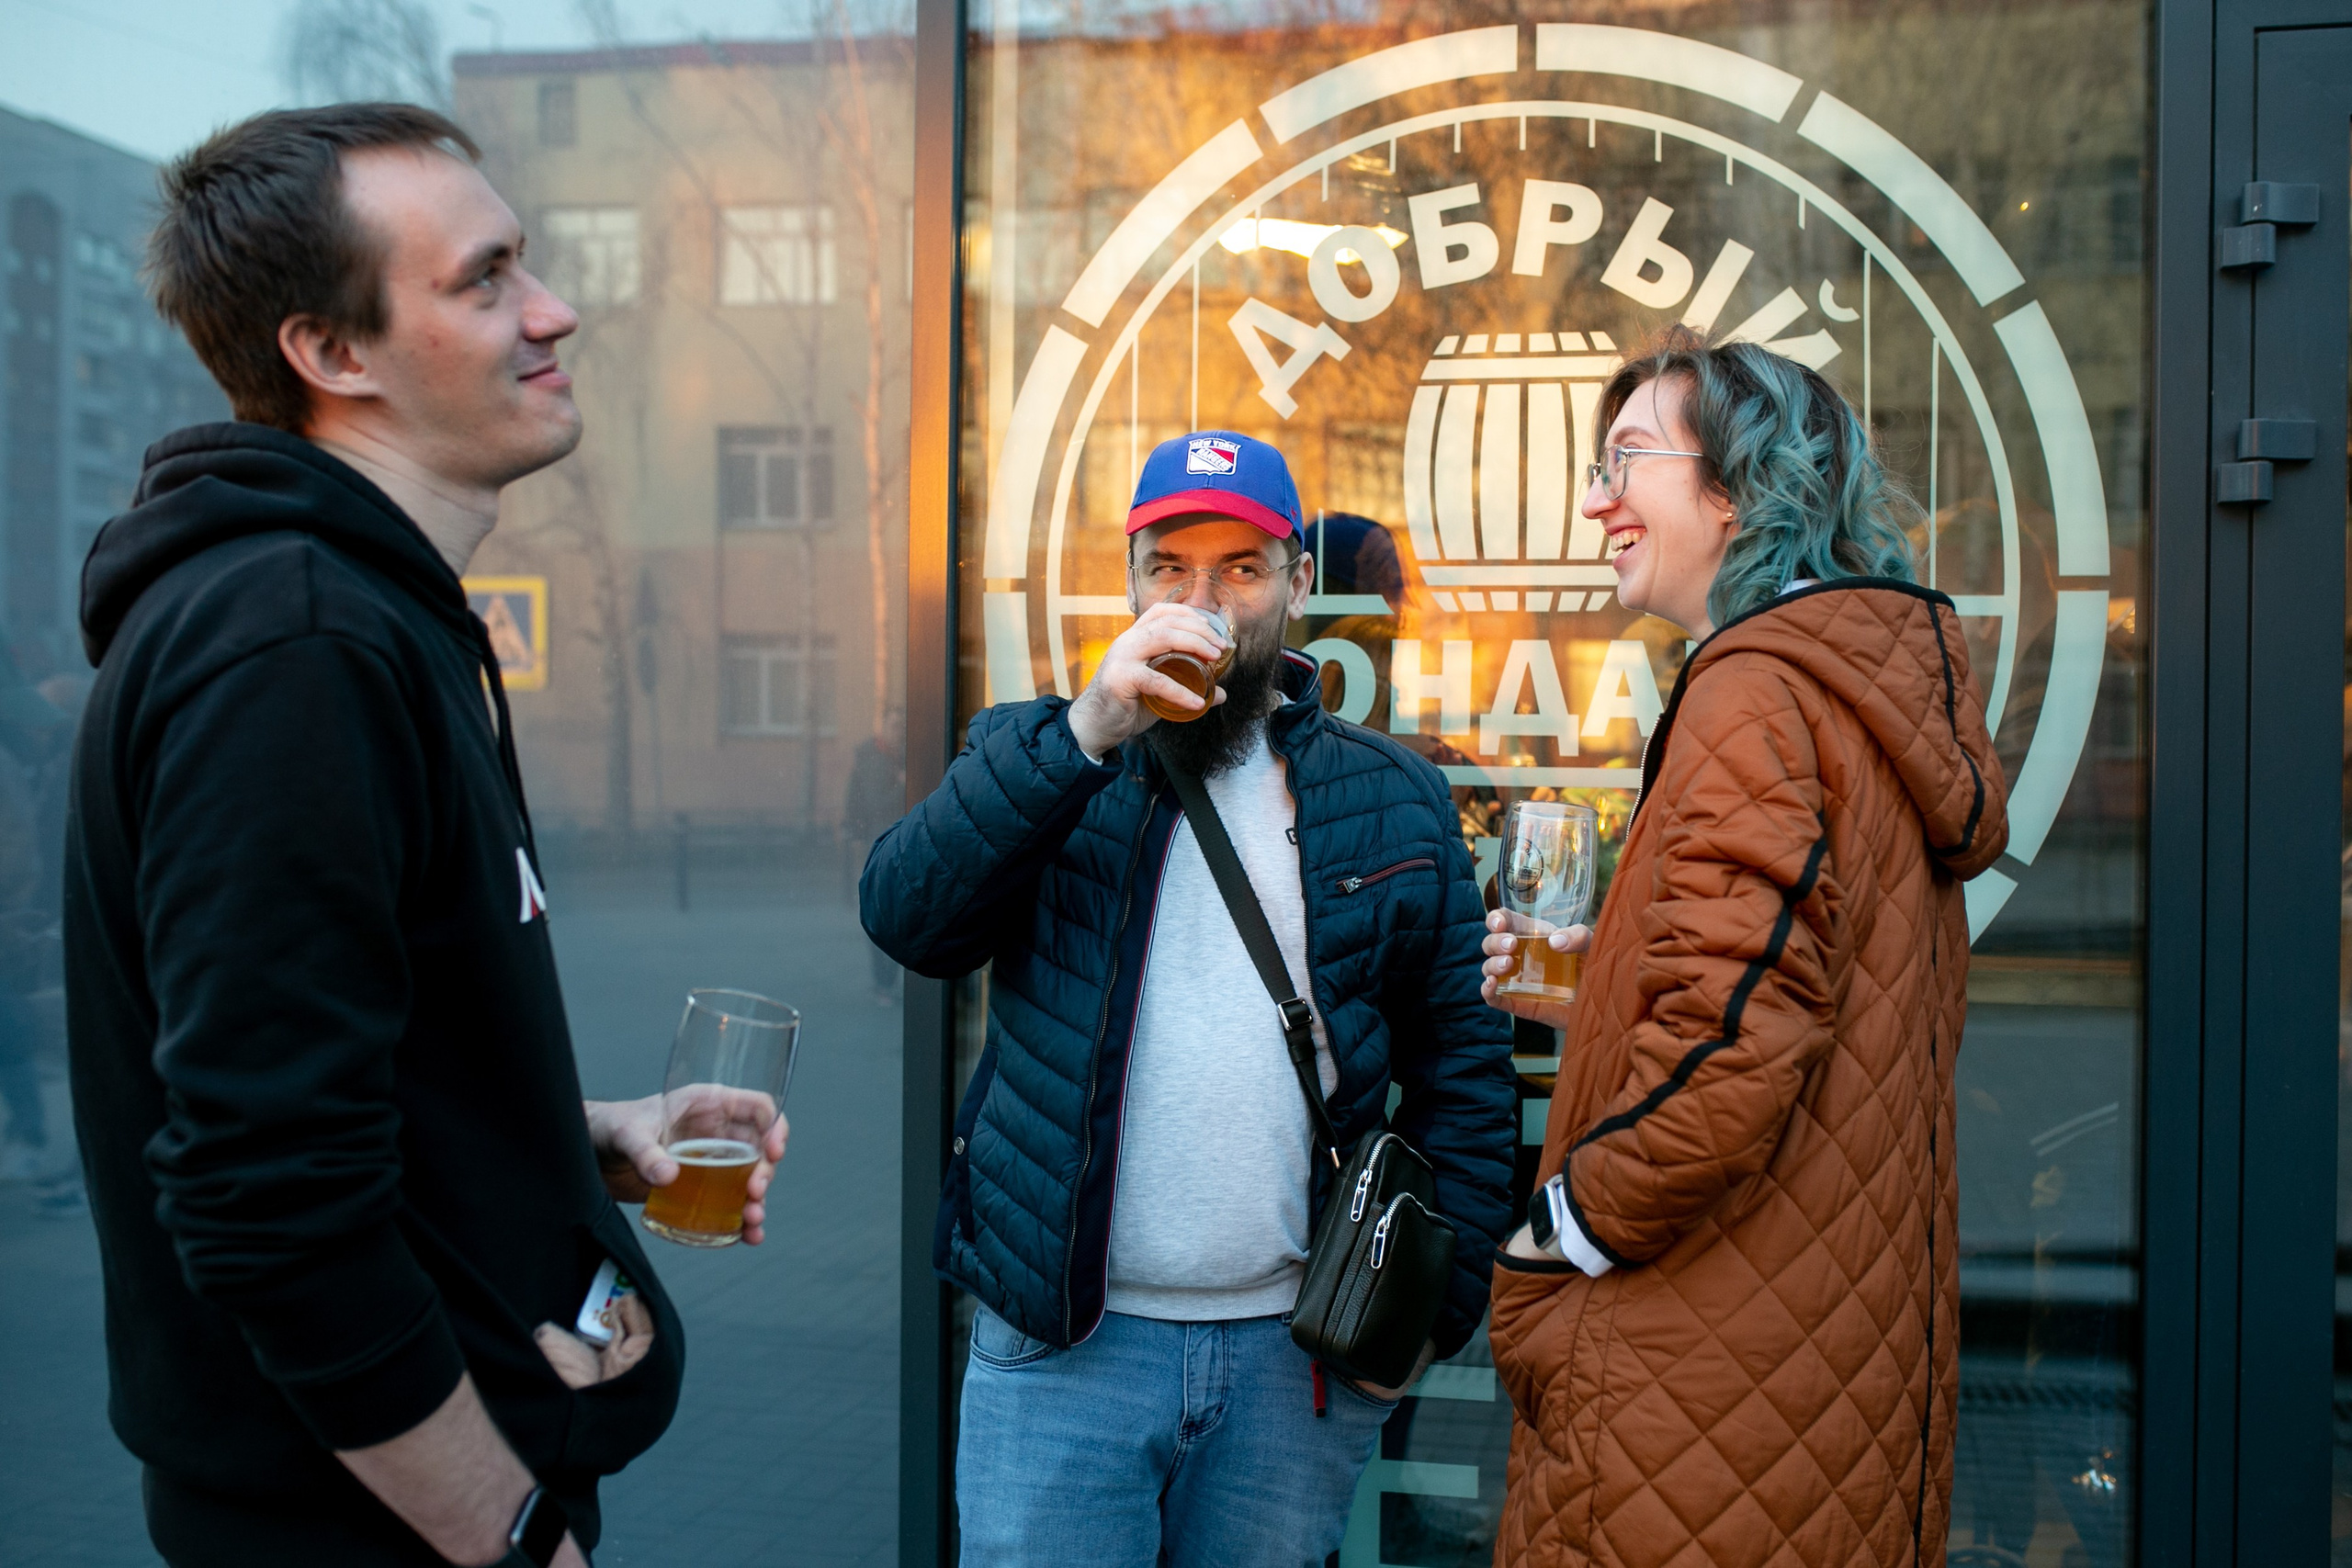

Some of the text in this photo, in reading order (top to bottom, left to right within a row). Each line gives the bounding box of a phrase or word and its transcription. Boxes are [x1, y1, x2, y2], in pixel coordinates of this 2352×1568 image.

[1191, 439, 1238, 453] NEW YORK
[1195, 447, 1233, 472] RANGERS
[1299, 637, 1698, 757] ОНДА
